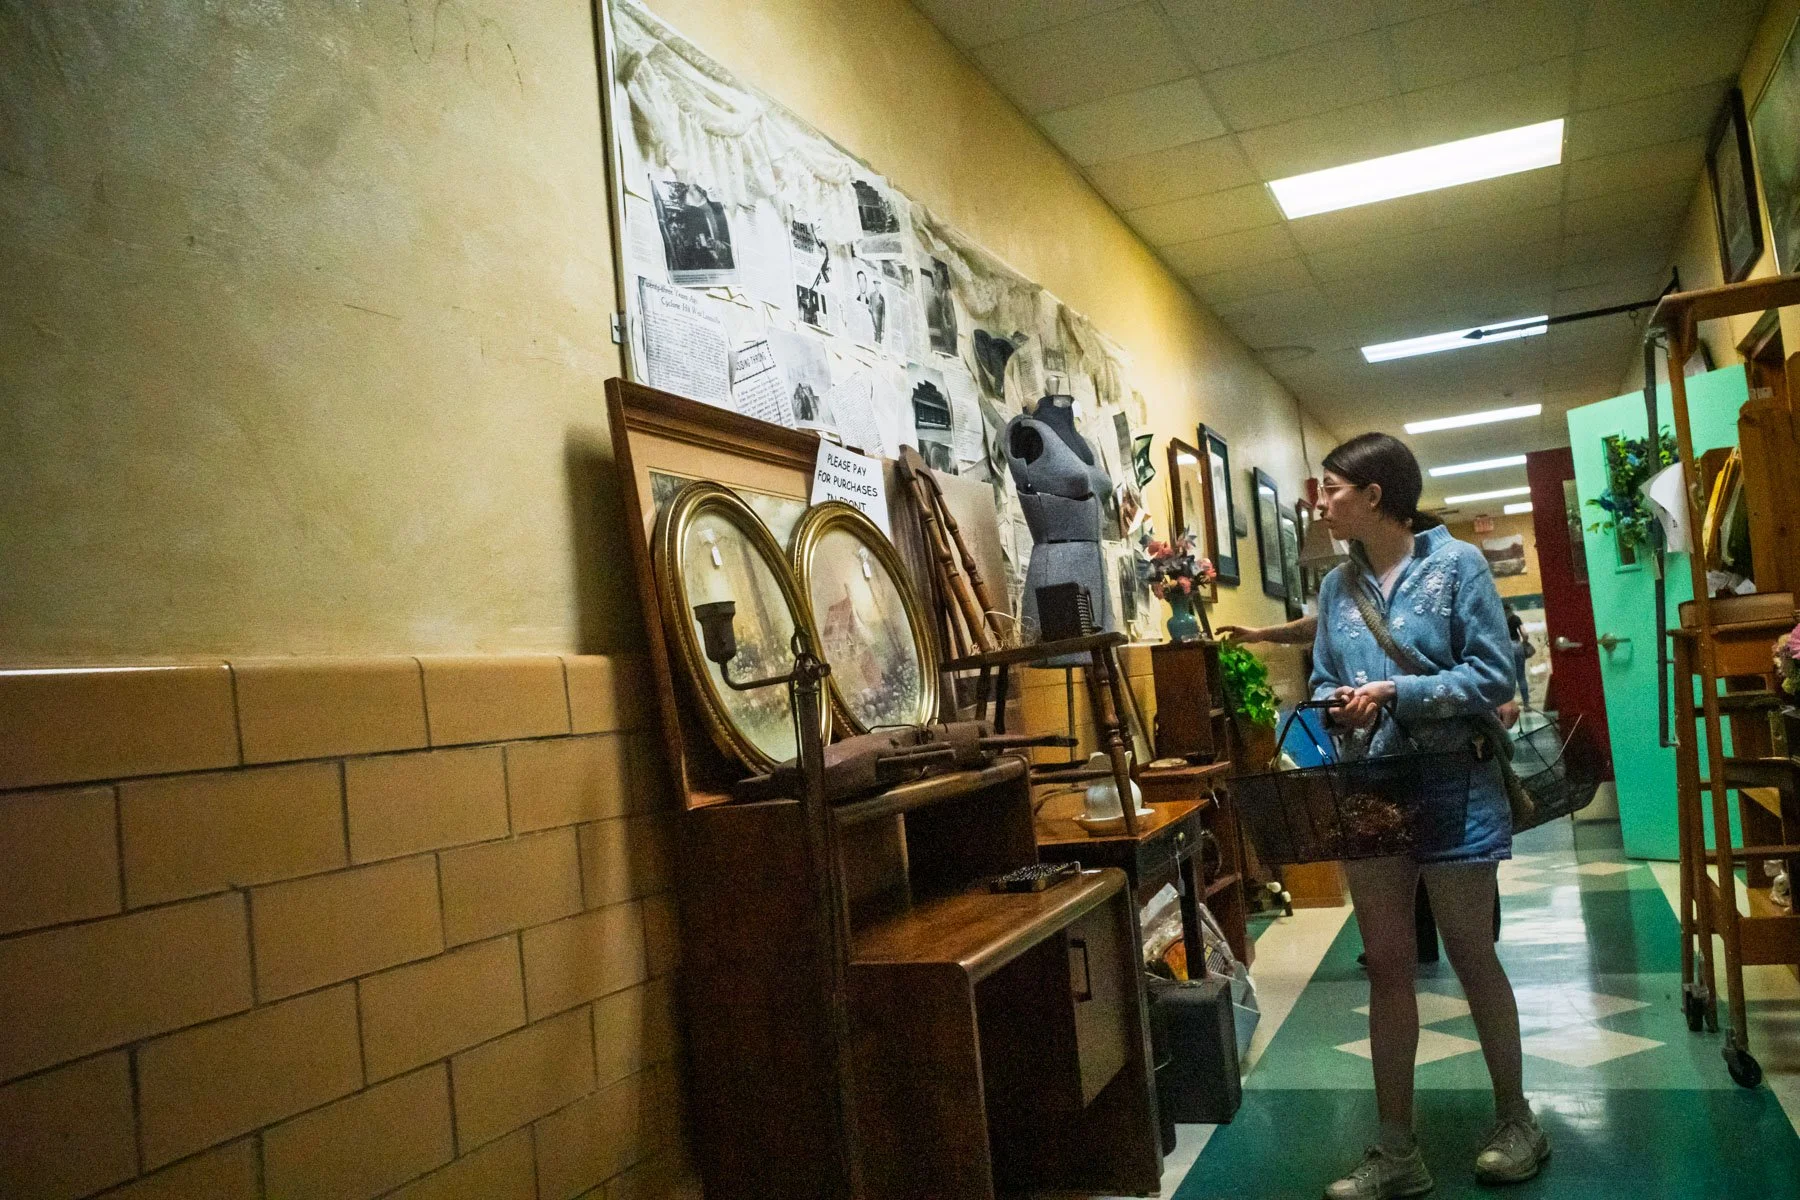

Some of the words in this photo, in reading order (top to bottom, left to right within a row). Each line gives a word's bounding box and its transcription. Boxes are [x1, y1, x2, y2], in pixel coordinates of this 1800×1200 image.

[827, 453, 851, 473] PLEASE
[852, 463, 867, 477] PAY
[817, 470, 831, 484] FOR
[833, 475, 878, 497] PURCHASES
